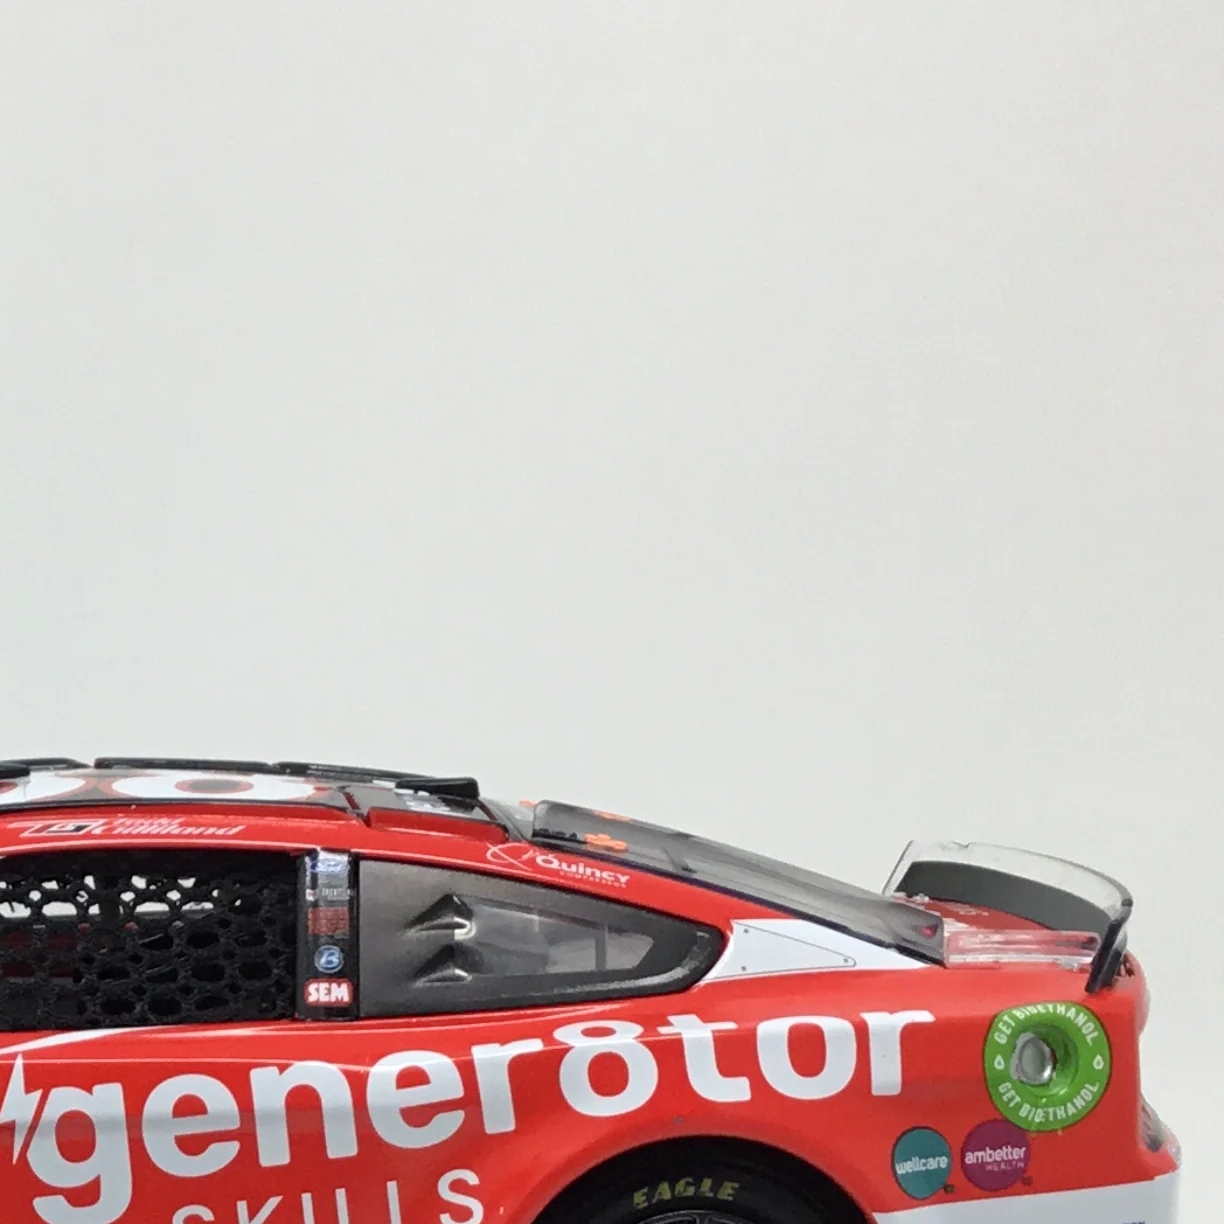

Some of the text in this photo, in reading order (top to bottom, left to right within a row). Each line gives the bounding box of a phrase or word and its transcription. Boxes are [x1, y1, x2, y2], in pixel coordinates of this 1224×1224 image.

[535, 853, 631, 884] Quincy
[308, 982, 349, 1003] SEM
[993, 1014, 1017, 1045] GET
[998, 1082, 1022, 1108] GET
[895, 1155, 949, 1175] wellcare
[964, 1145, 1026, 1164] ambetter
[633, 1176, 741, 1210] EAGLE
